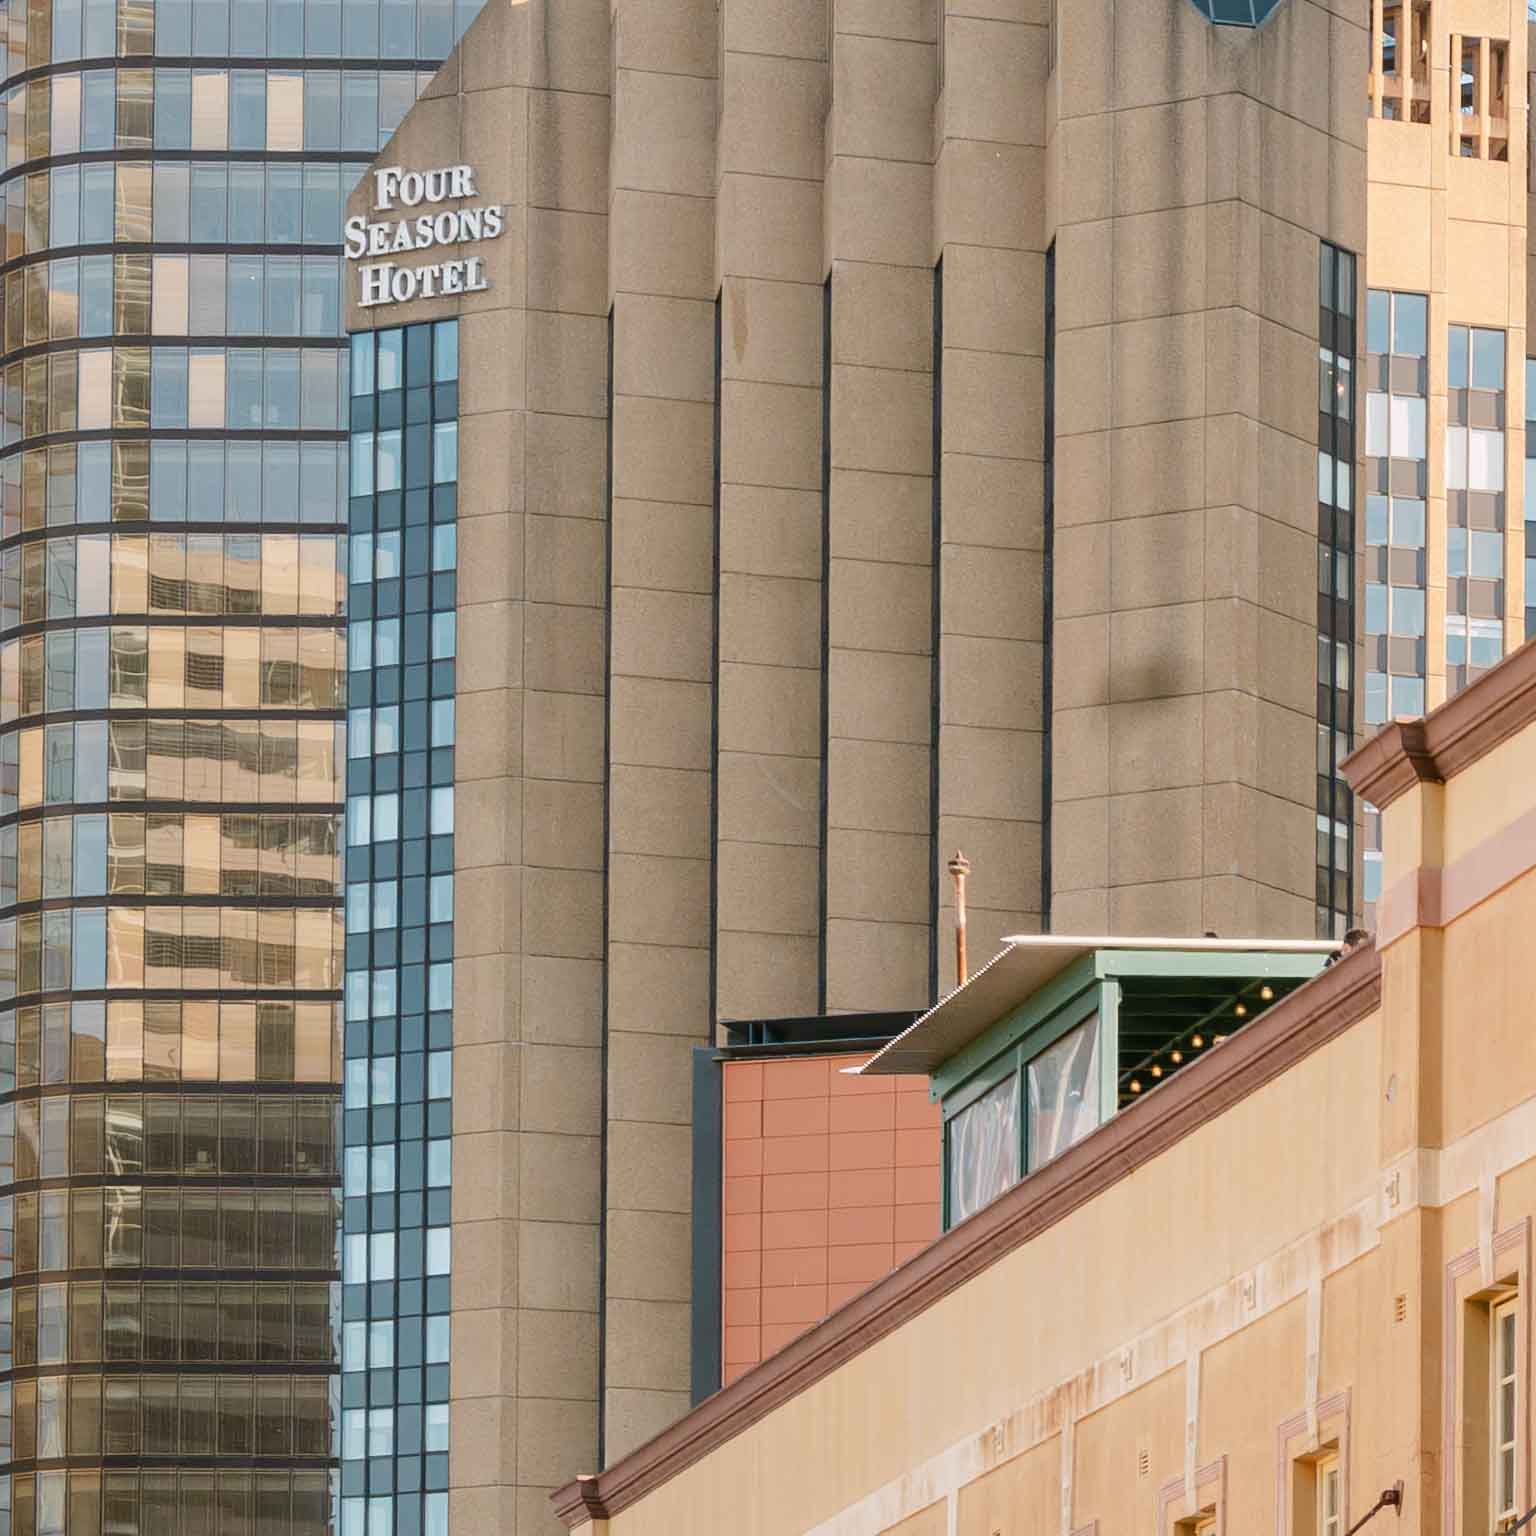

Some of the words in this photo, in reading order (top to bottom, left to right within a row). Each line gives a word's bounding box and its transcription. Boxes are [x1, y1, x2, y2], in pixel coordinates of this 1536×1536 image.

[373, 165, 480, 211] FOUR
[343, 205, 505, 260] SEASONS
[357, 256, 489, 308] HOTEL
